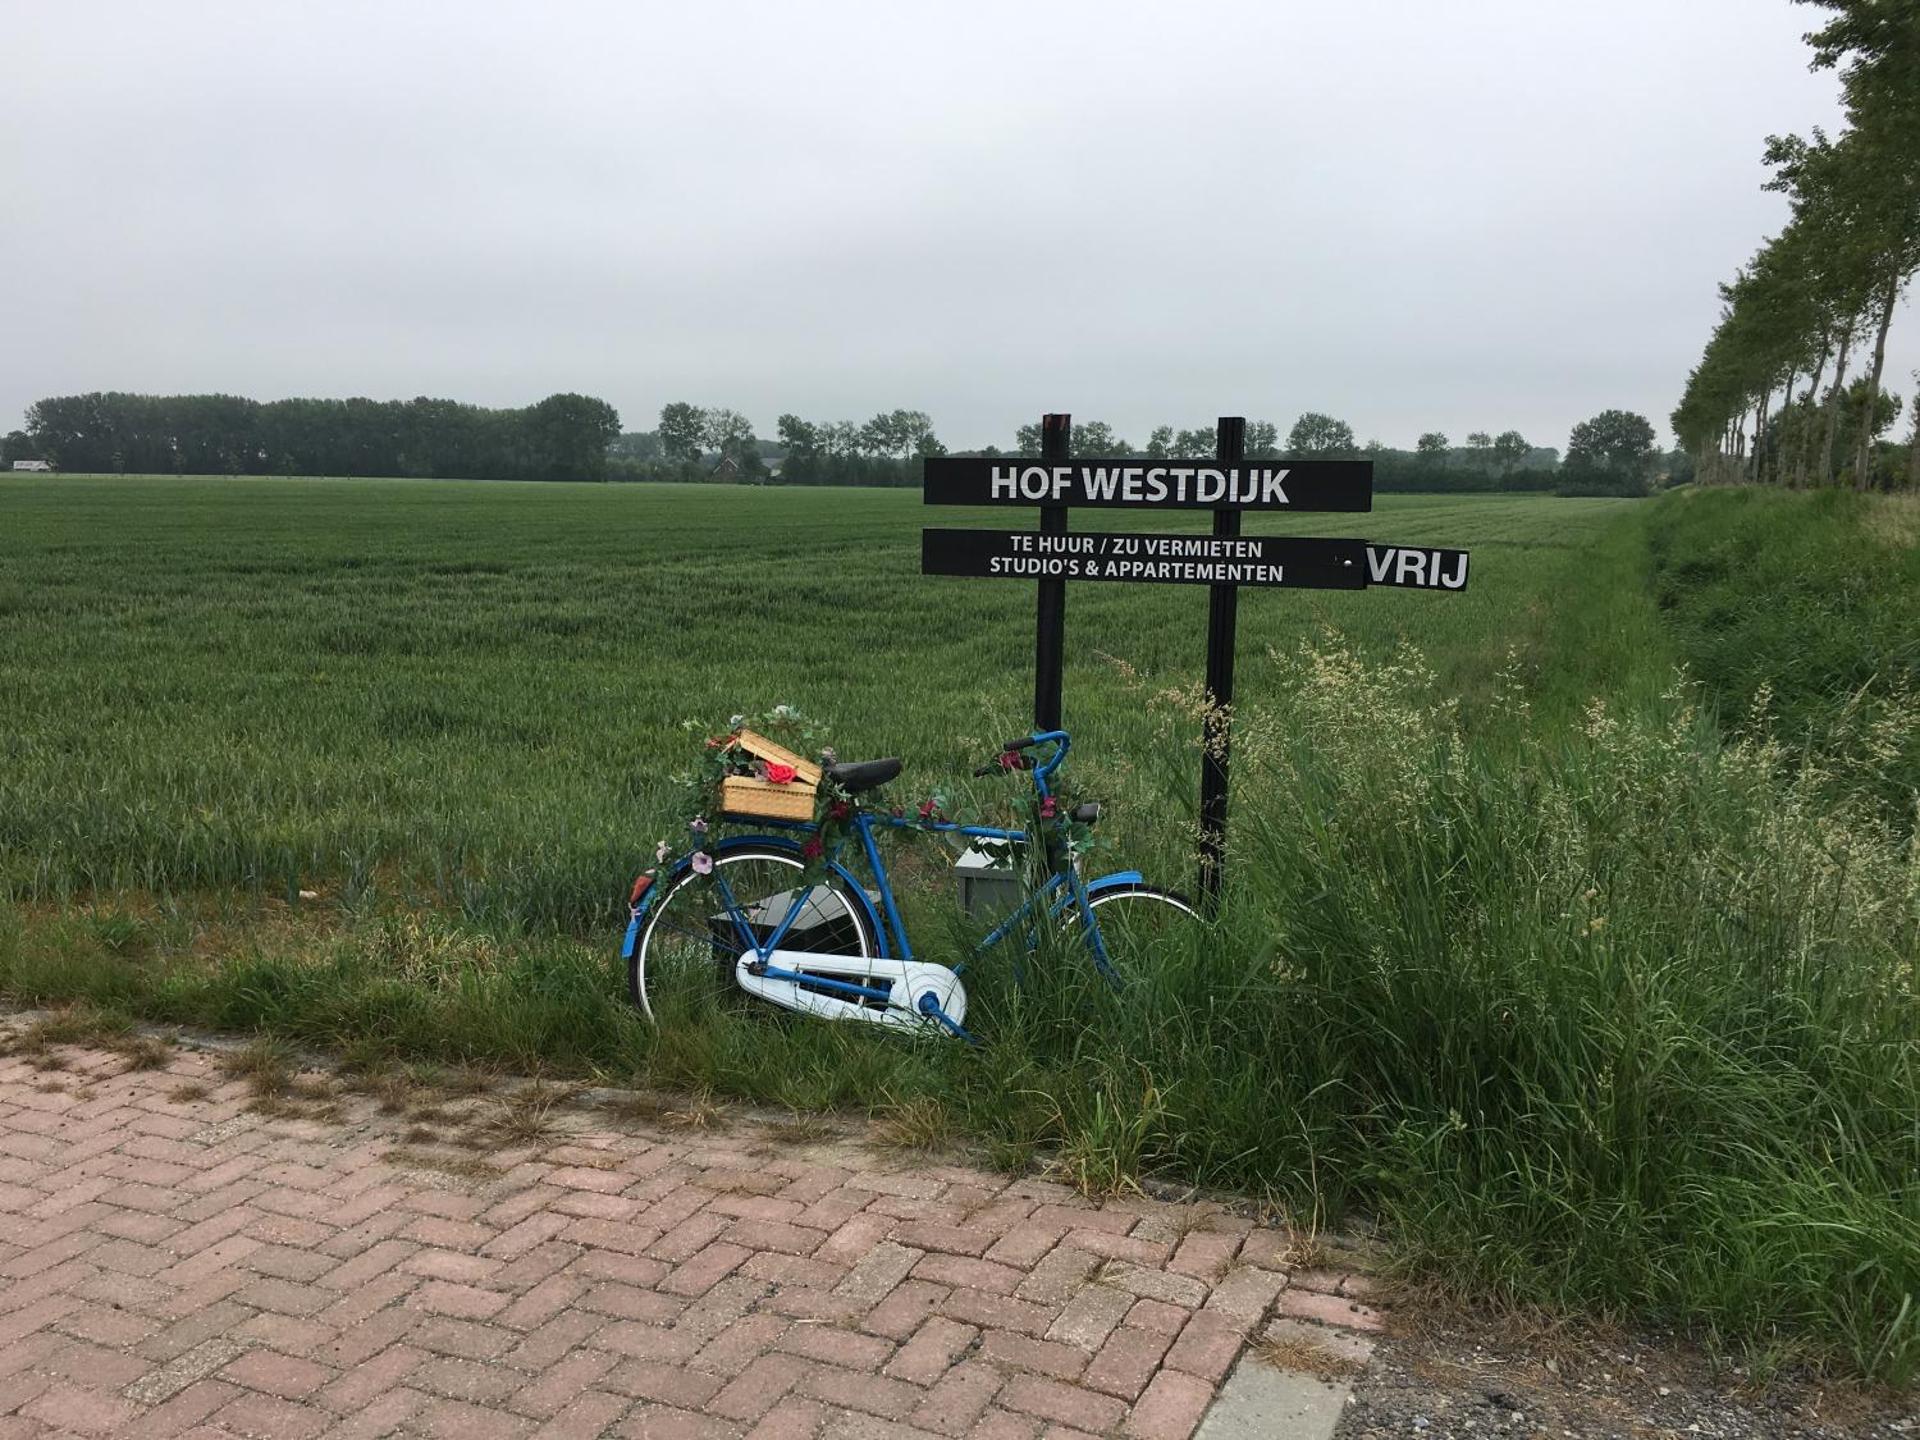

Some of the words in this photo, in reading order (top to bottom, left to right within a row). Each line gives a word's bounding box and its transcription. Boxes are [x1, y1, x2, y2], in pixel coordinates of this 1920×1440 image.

[990, 466, 1072, 500] HOF
[1082, 468, 1291, 505] WESTDIJK
[1011, 535, 1033, 552] TE
[1038, 536, 1094, 554] HUUR
[1099, 537, 1108, 555] /
[1112, 538, 1139, 555] ZU
[1145, 539, 1263, 558] VERMIETEN
[990, 556, 1080, 576] STUDIO'S
[1085, 560, 1100, 577] &
[1104, 560, 1284, 583] APPARTEMENTEN
[1366, 548, 1467, 589] VRIJ
